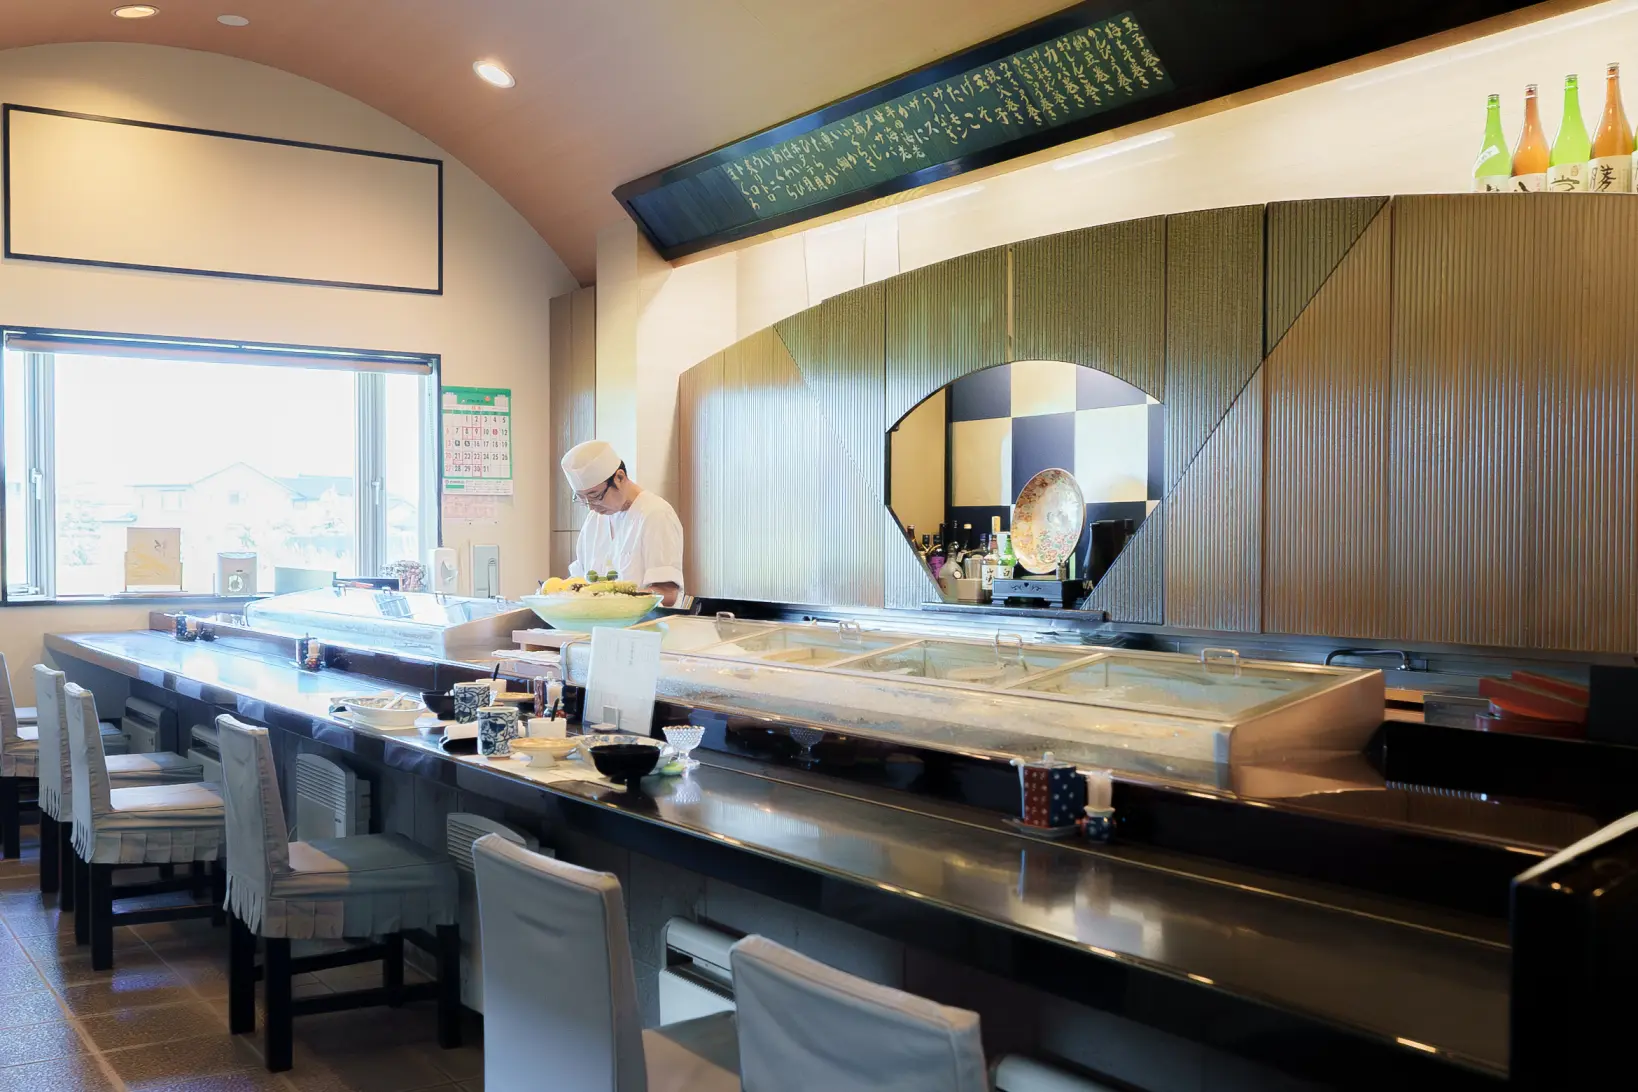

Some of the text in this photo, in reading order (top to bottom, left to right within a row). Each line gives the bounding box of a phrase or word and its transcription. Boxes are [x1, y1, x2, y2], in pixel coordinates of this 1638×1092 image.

[898, 104, 929, 143] かに
[946, 83, 980, 129] たこ
[790, 142, 828, 189] ホタテ貝
[798, 139, 836, 184] ひらめ
[829, 129, 858, 164] いか
[733, 163, 760, 194] トロ
[752, 155, 781, 190] ウニ
[760, 154, 797, 199] いくら
